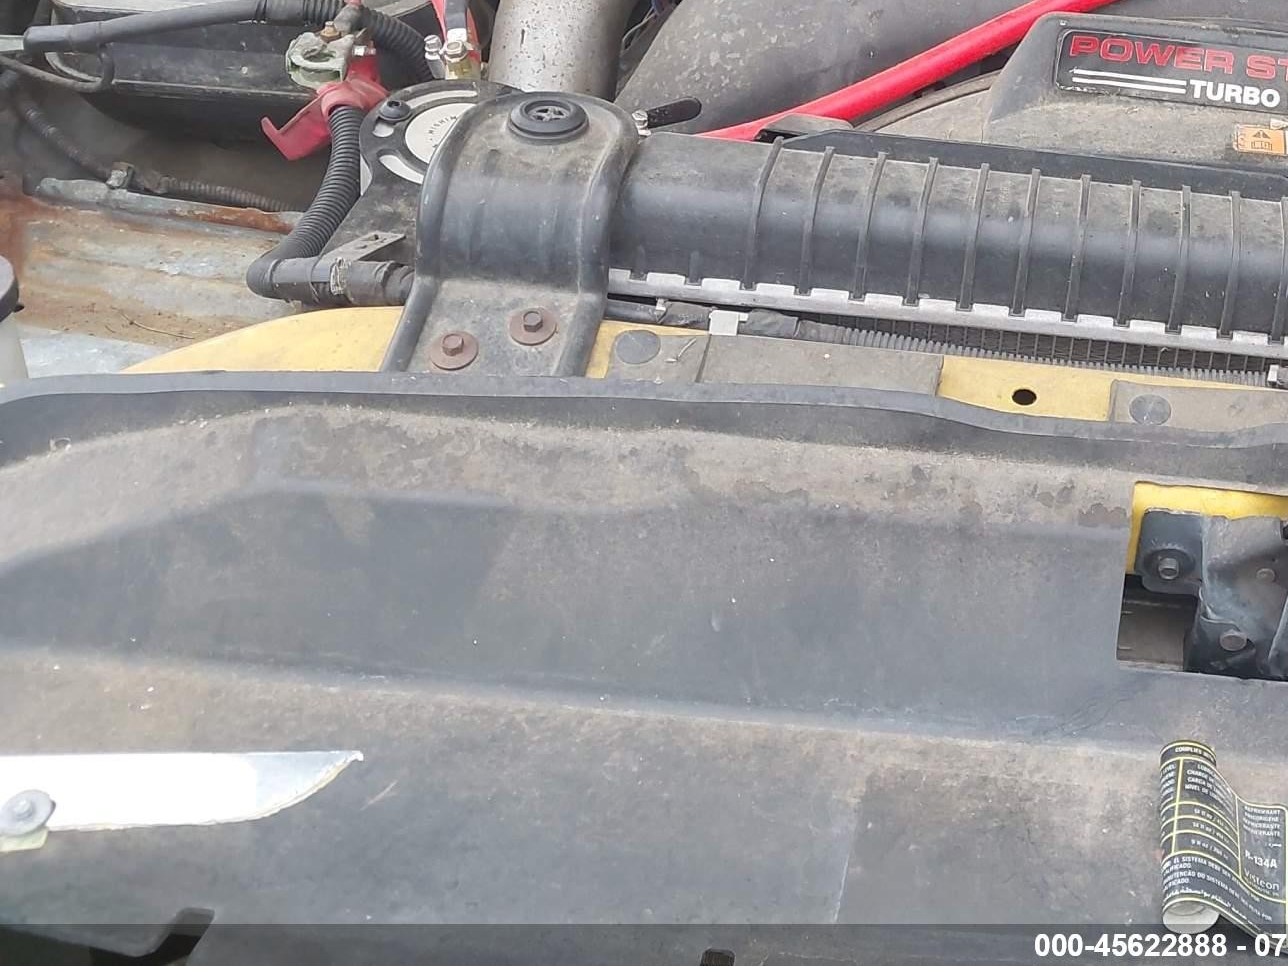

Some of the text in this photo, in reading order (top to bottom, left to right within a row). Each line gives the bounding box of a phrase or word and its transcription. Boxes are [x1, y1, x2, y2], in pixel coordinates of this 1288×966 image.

[1069, 34, 1235, 76] POWER
[1190, 79, 1281, 110] TURBO
[1245, 849, 1278, 868] R-134A
[1244, 867, 1280, 891] Visteon
